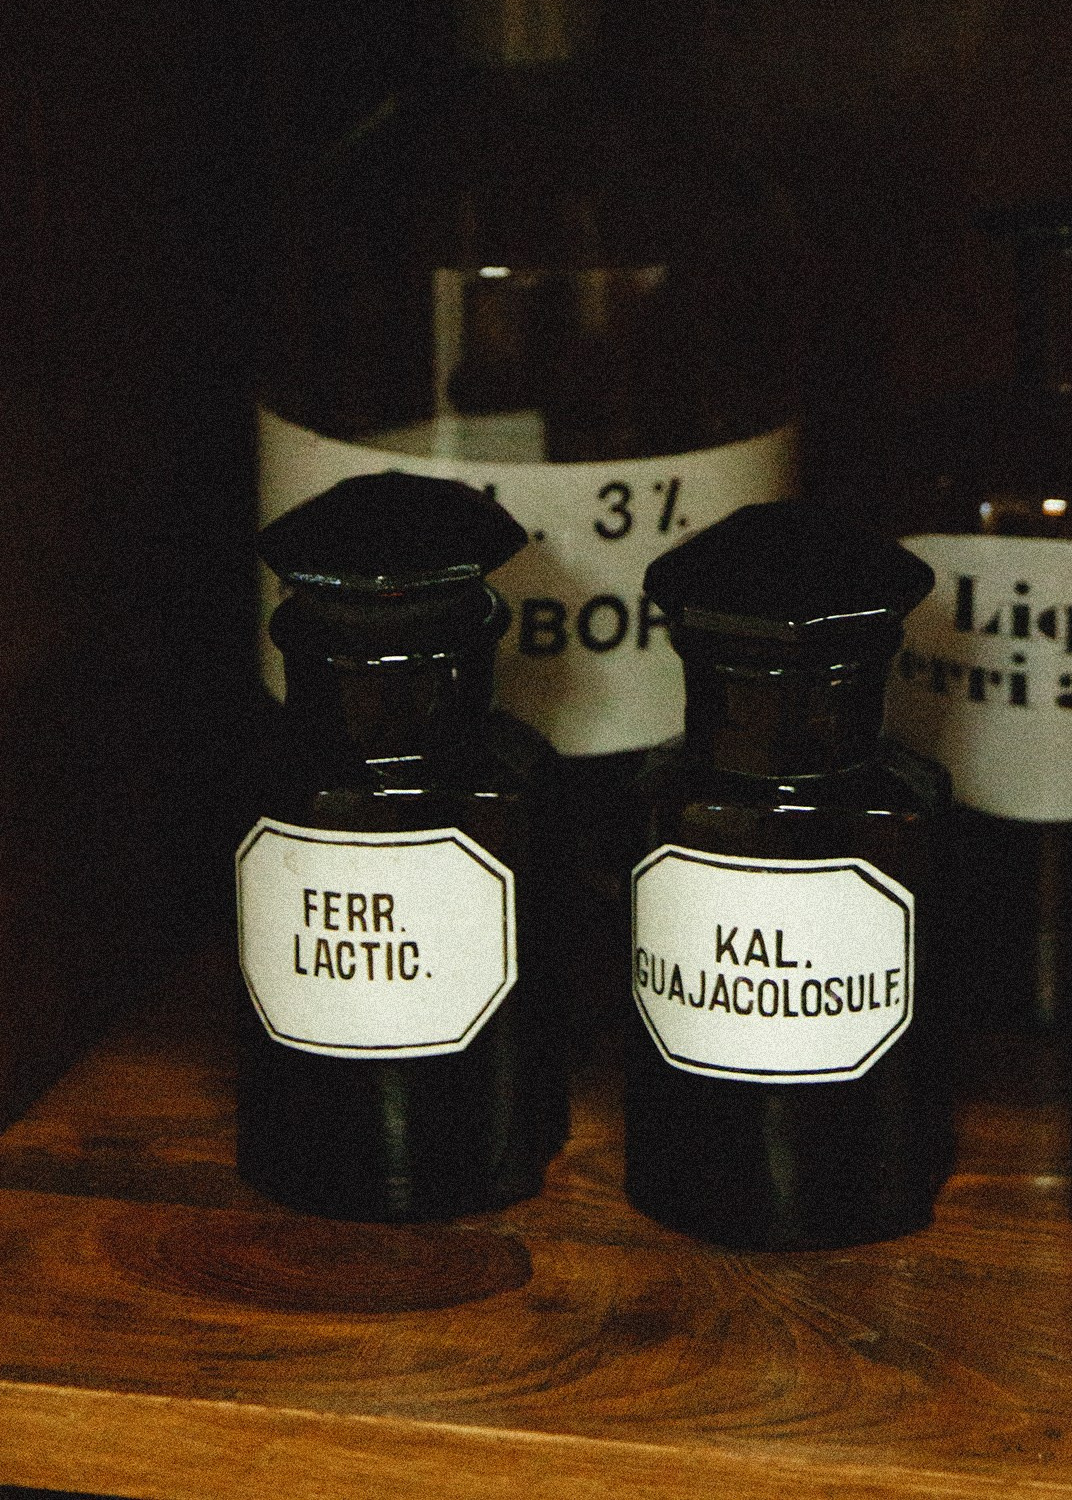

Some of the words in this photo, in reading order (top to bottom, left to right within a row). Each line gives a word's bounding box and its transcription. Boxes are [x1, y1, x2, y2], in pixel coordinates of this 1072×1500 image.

[303, 888, 406, 933] FERR.
[293, 933, 432, 981] LACTIC.
[716, 924, 813, 970] KAL.
